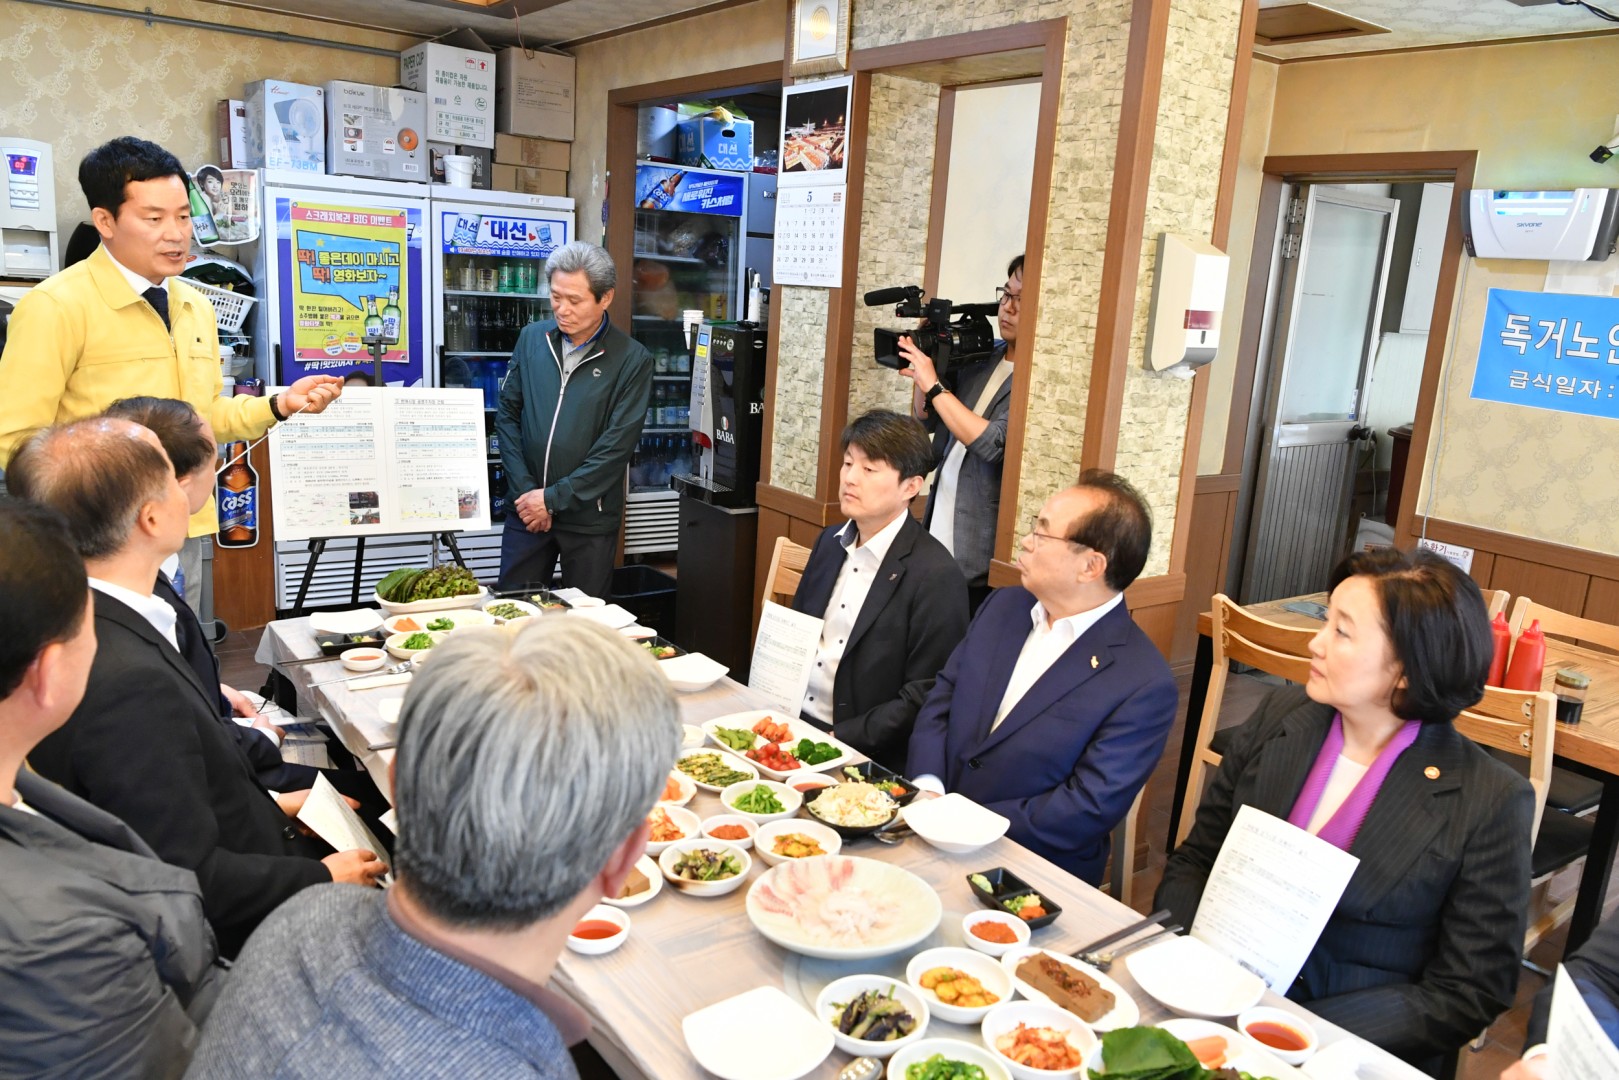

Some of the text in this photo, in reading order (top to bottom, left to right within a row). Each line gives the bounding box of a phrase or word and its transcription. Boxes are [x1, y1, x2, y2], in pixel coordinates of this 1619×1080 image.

[718, 143, 738, 155] 대선
[807, 191, 812, 202] 5
[353, 214, 368, 225] BIG
[370, 215, 392, 226] 이벤트
[456, 217, 479, 234] 대선
[490, 220, 527, 242] 대선
[297, 249, 400, 267] 딱! 좋은데이 마시고
[312, 267, 388, 284] 딱! 영화보자~
[1508, 370, 1602, 400] 급식일자
[716, 429, 734, 444] BABA
[221, 491, 252, 512] Cass
